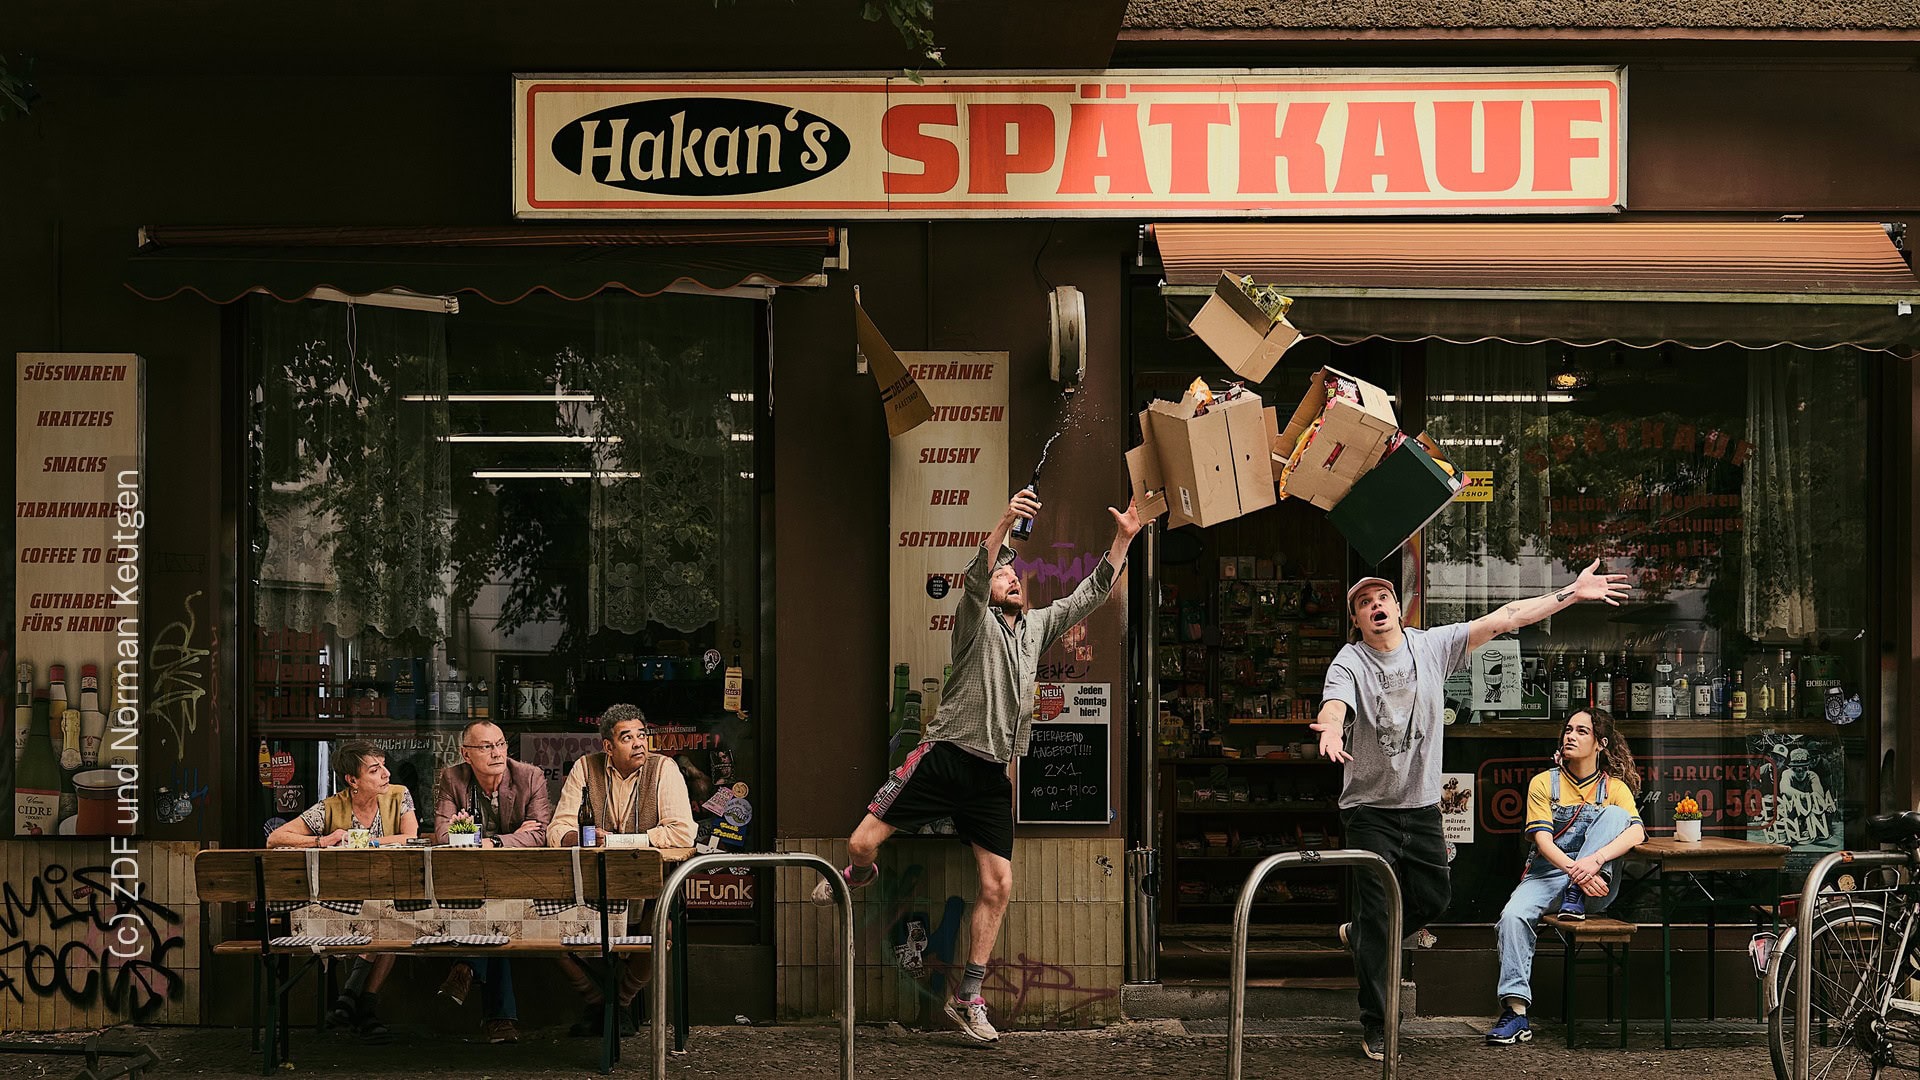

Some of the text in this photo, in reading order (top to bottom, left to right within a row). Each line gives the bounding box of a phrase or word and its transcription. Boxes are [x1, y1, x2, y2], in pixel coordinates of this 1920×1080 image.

[580, 83, 1603, 194] Hakan's SPÄTKAUF
[23, 361, 127, 381] SÜSSWAREN
[908, 360, 994, 380] GETRÄNKE
[36, 410, 114, 427] KRATZEIS
[918, 447, 981, 464] SLUSHY
[42, 456, 108, 473] SNACKS
[930, 489, 970, 506] BIER
[20, 547, 77, 564] COFFEE
[82, 547, 101, 564] TO
[29, 592, 119, 610] GUTHABEN
[21, 612, 64, 632] FÜRS
[1041, 687, 1063, 698] NEU!
[1077, 685, 1103, 695] Jeden
[1073, 696, 1107, 707] Sonntag
[1079, 707, 1101, 717] hier!
[1030, 729, 1084, 743] FEIERABEND
[271, 755, 292, 765] NEU!
[1494, 767, 1545, 784] INTE
[1673, 765, 1762, 781] DRUCKEN
[17, 805, 52, 816] CIDRE
